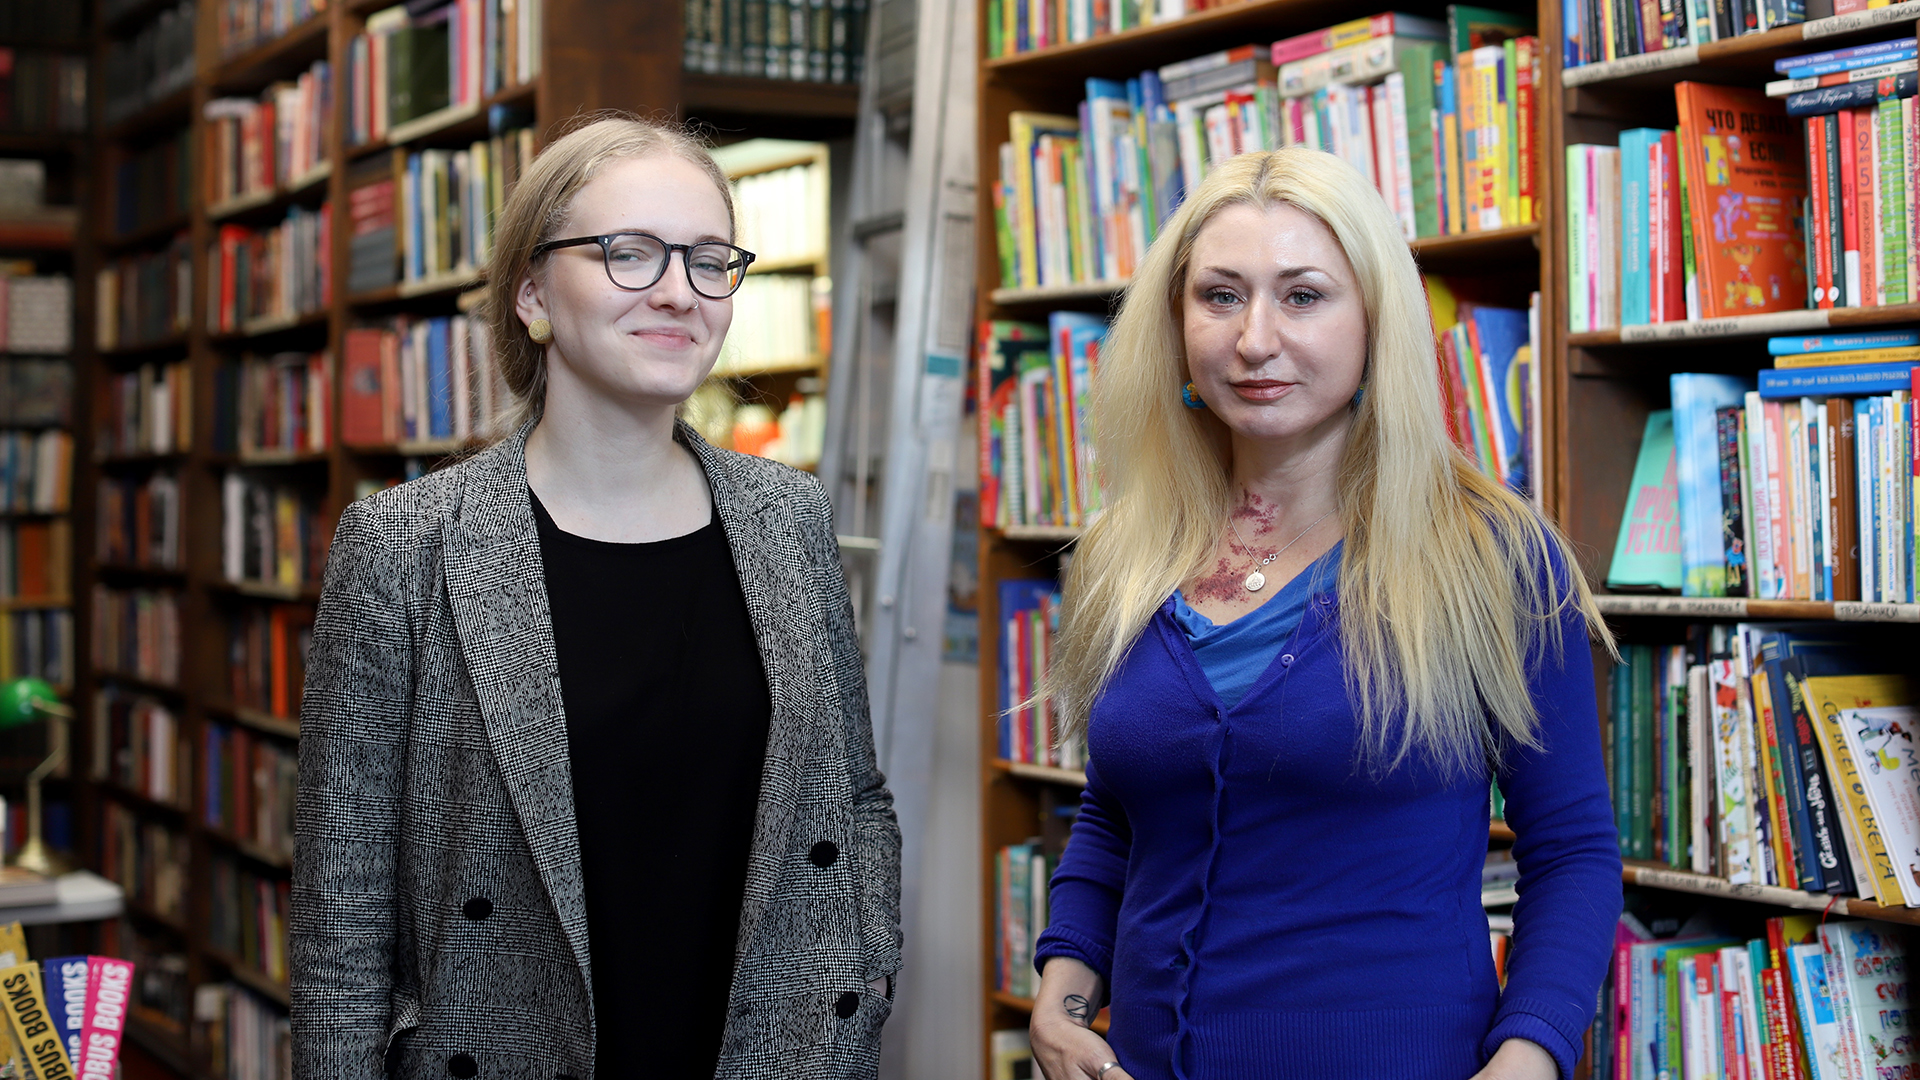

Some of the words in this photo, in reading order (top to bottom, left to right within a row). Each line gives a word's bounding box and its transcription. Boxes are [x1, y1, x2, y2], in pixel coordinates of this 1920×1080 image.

[1705, 108, 1736, 130] ЧТО
[1857, 118, 1870, 129] ОТ
[1857, 131, 1871, 152] 2
[1859, 167, 1871, 188] 5
[1861, 200, 1871, 259] ЧУКОВСКИЙ
[1864, 264, 1873, 303] КОРНЕЙ
[1632, 485, 1680, 523] ПРОС
[3, 973, 49, 1039] BOOKS
[61, 960, 88, 1030] BOOKS
[91, 962, 130, 1031] BOOKS
[1879, 1009, 1915, 1030] ПОТ
